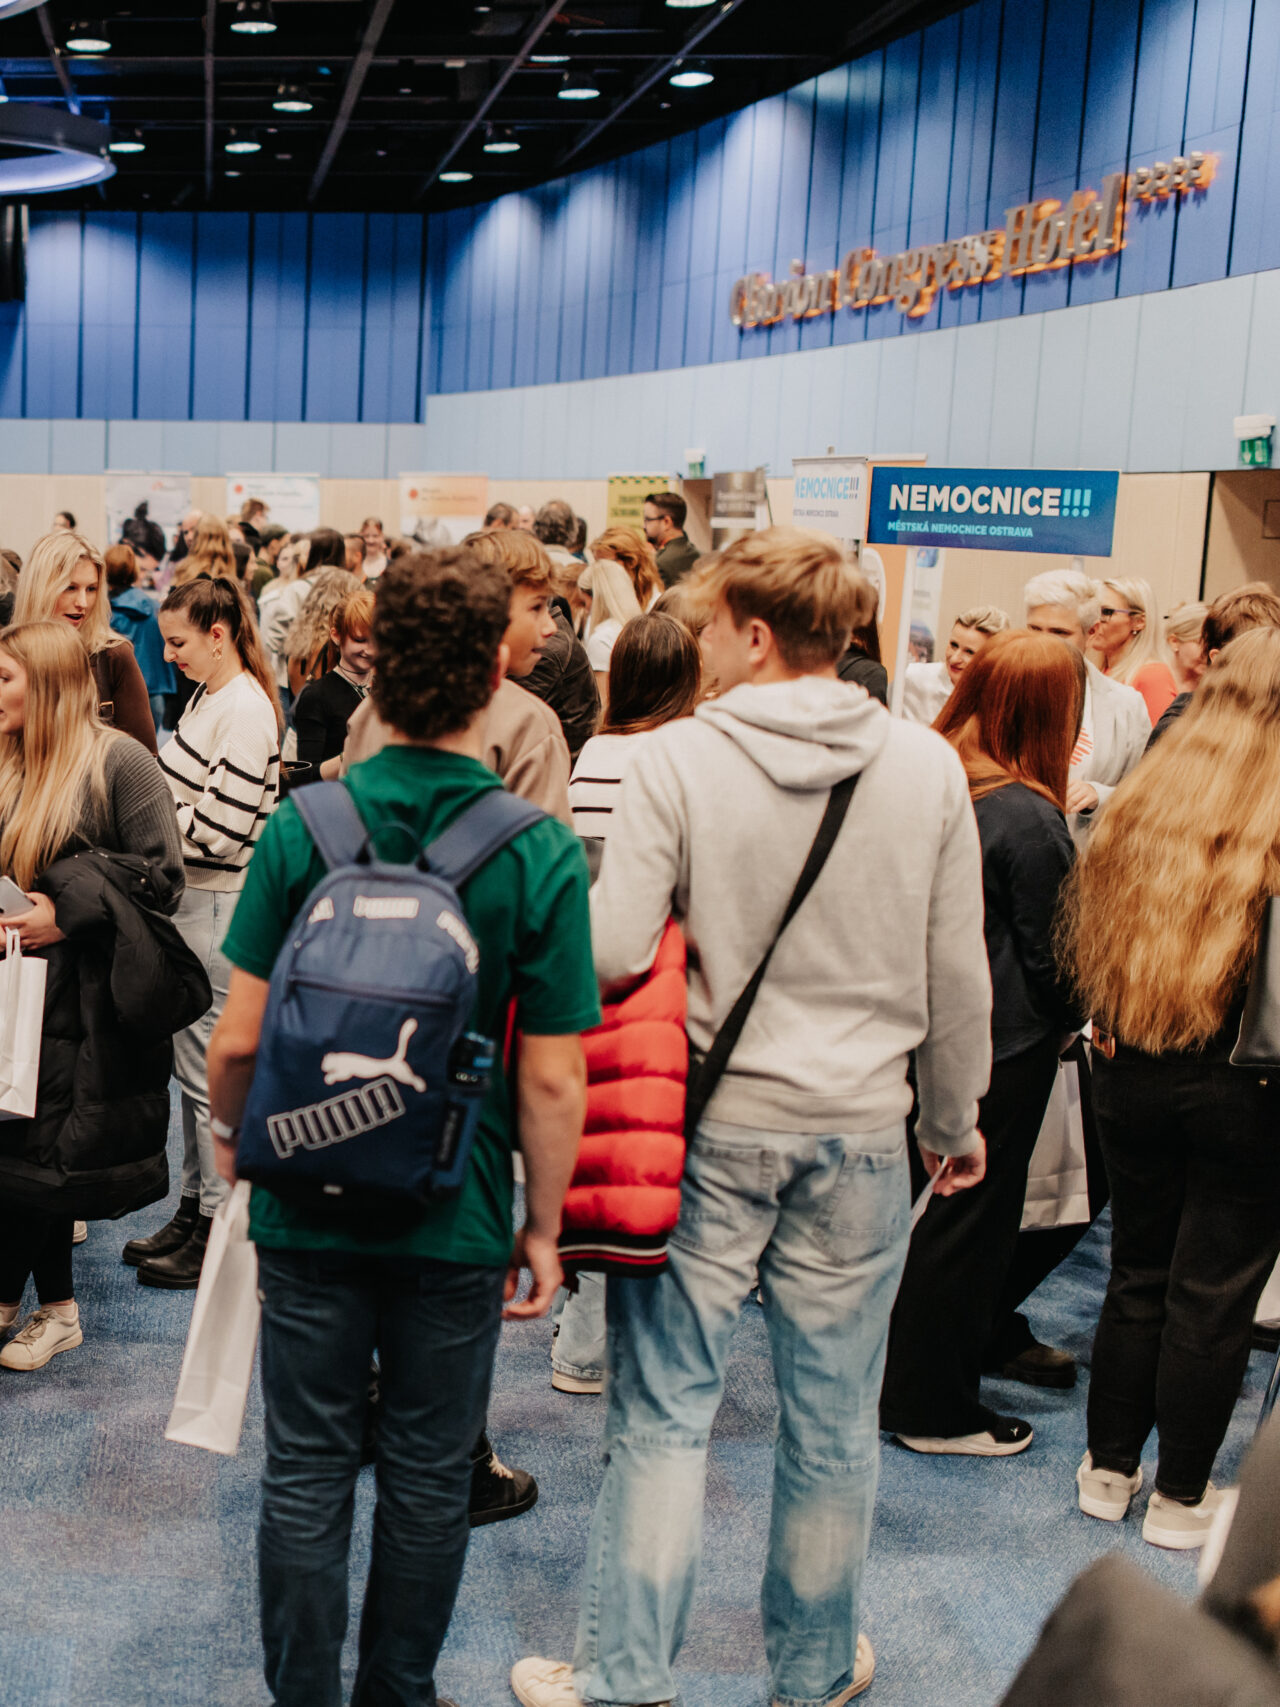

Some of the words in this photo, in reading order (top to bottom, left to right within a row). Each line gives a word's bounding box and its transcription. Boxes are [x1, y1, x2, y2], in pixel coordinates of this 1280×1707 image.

[839, 229, 1004, 315] Congress
[1000, 172, 1128, 275] Hotel
[888, 484, 1092, 518] NEMOCNICE!!!
[887, 520, 930, 533] MĚSTSKÁ
[931, 522, 988, 536] NEMOCNICE
[988, 526, 1034, 538] OSTRAVA
